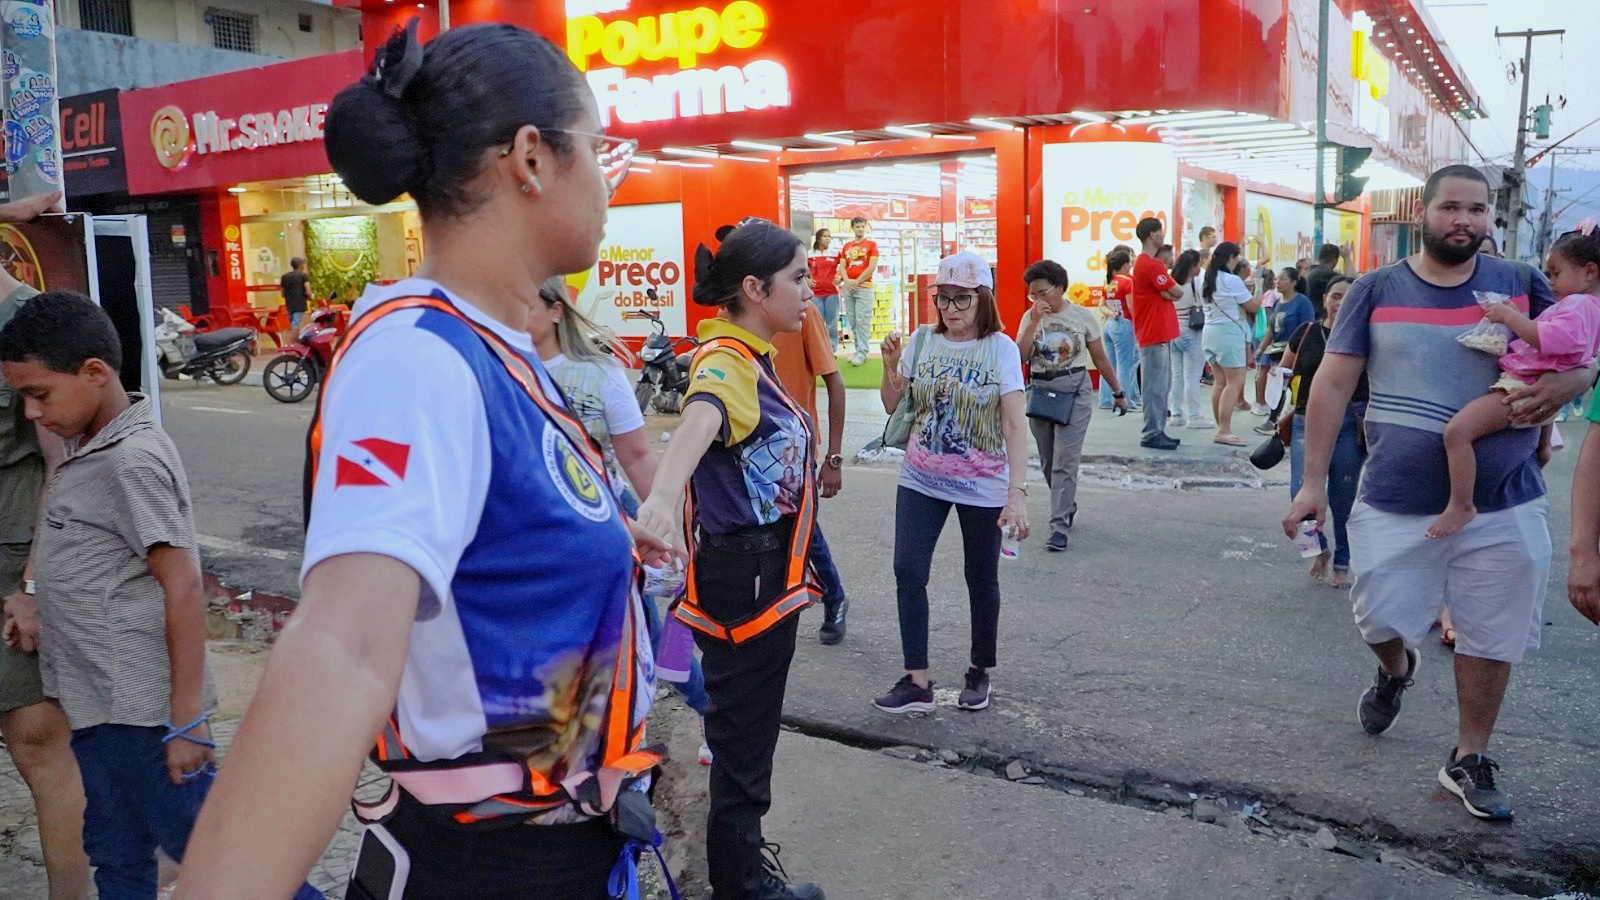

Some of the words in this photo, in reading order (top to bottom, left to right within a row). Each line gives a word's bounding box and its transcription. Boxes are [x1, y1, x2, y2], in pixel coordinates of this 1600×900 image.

[566, 1, 766, 72] Poupe
[587, 59, 791, 127] Farma
[1063, 191, 1078, 206] o
[1083, 186, 1150, 207] Menor
[599, 249, 608, 260] o
[610, 245, 655, 262] Menor
[598, 260, 680, 292] Preço
[614, 291, 632, 307] do
[632, 290, 674, 307] Brasil
[545, 429, 554, 458] Noss
[548, 460, 556, 472] de
[555, 472, 578, 508] Guarda
